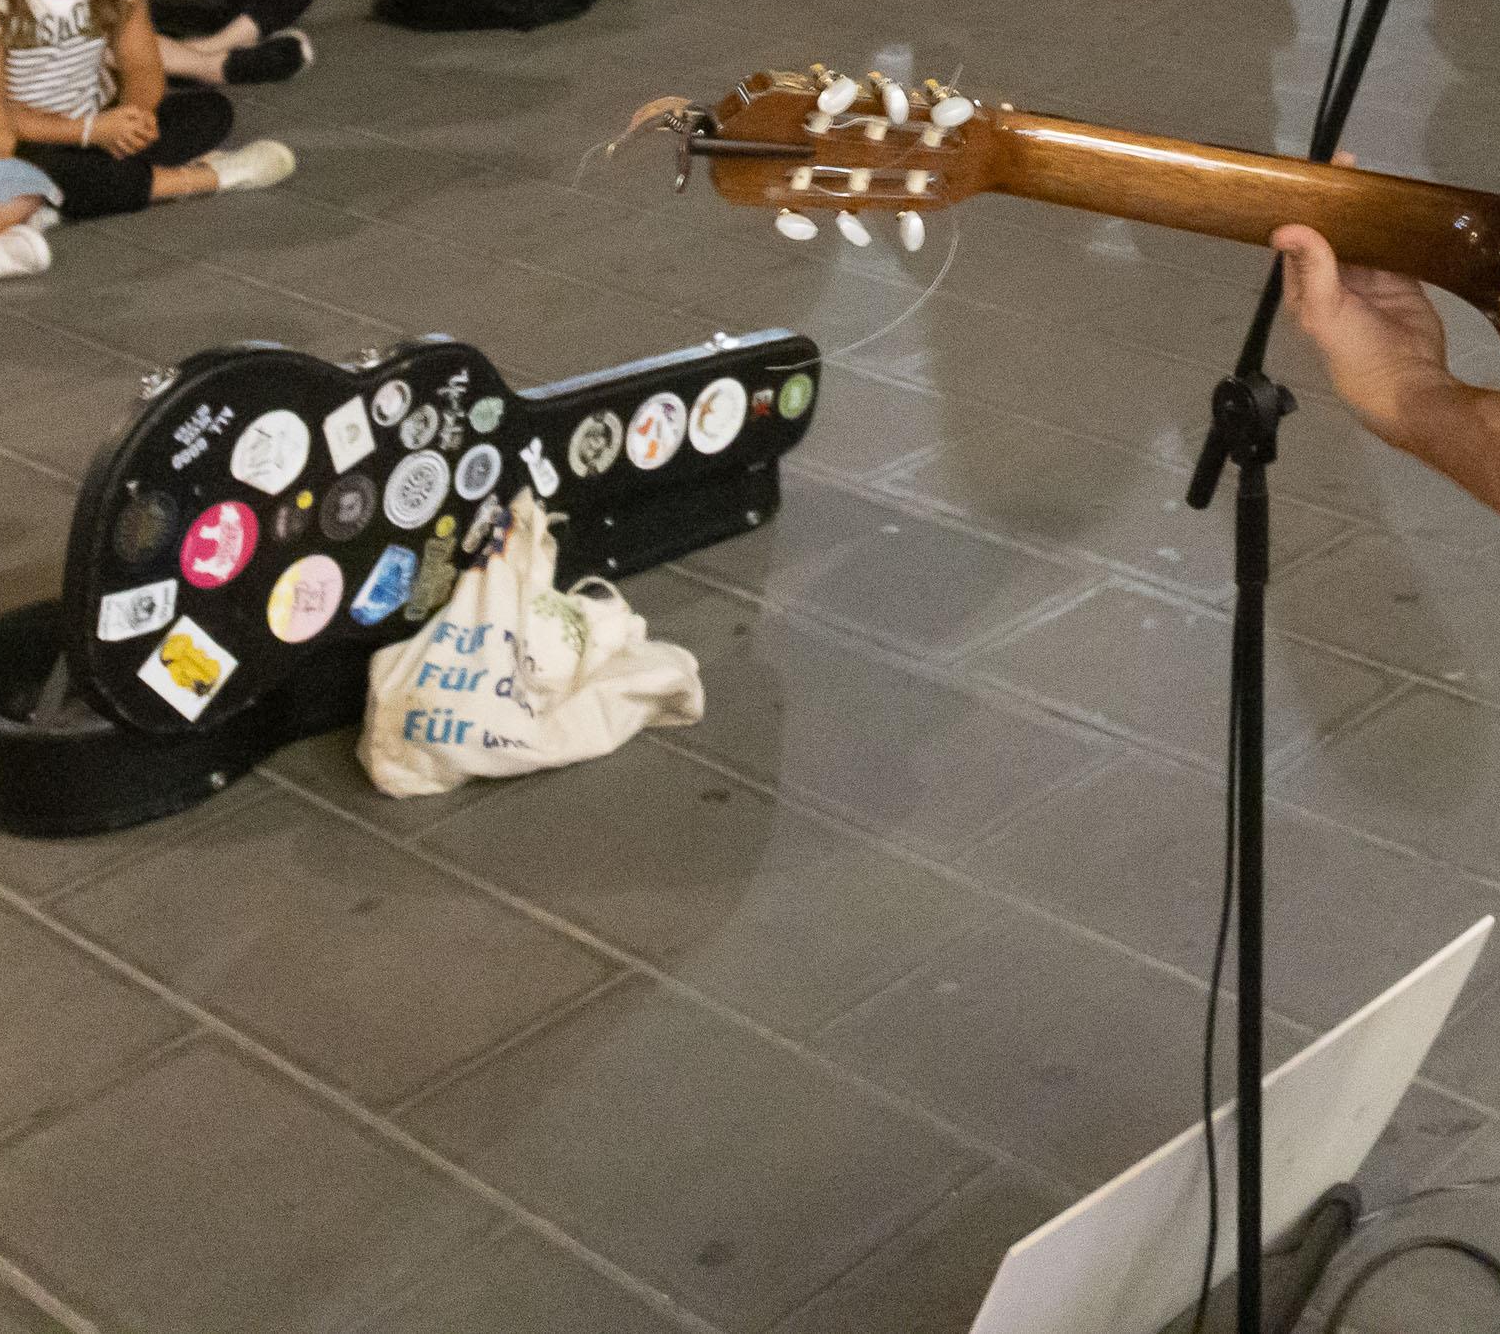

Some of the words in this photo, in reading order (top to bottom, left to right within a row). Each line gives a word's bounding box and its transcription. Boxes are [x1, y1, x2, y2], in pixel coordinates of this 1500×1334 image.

[432, 619, 494, 655] Für
[416, 660, 489, 693] Für
[402, 707, 476, 745] Für
